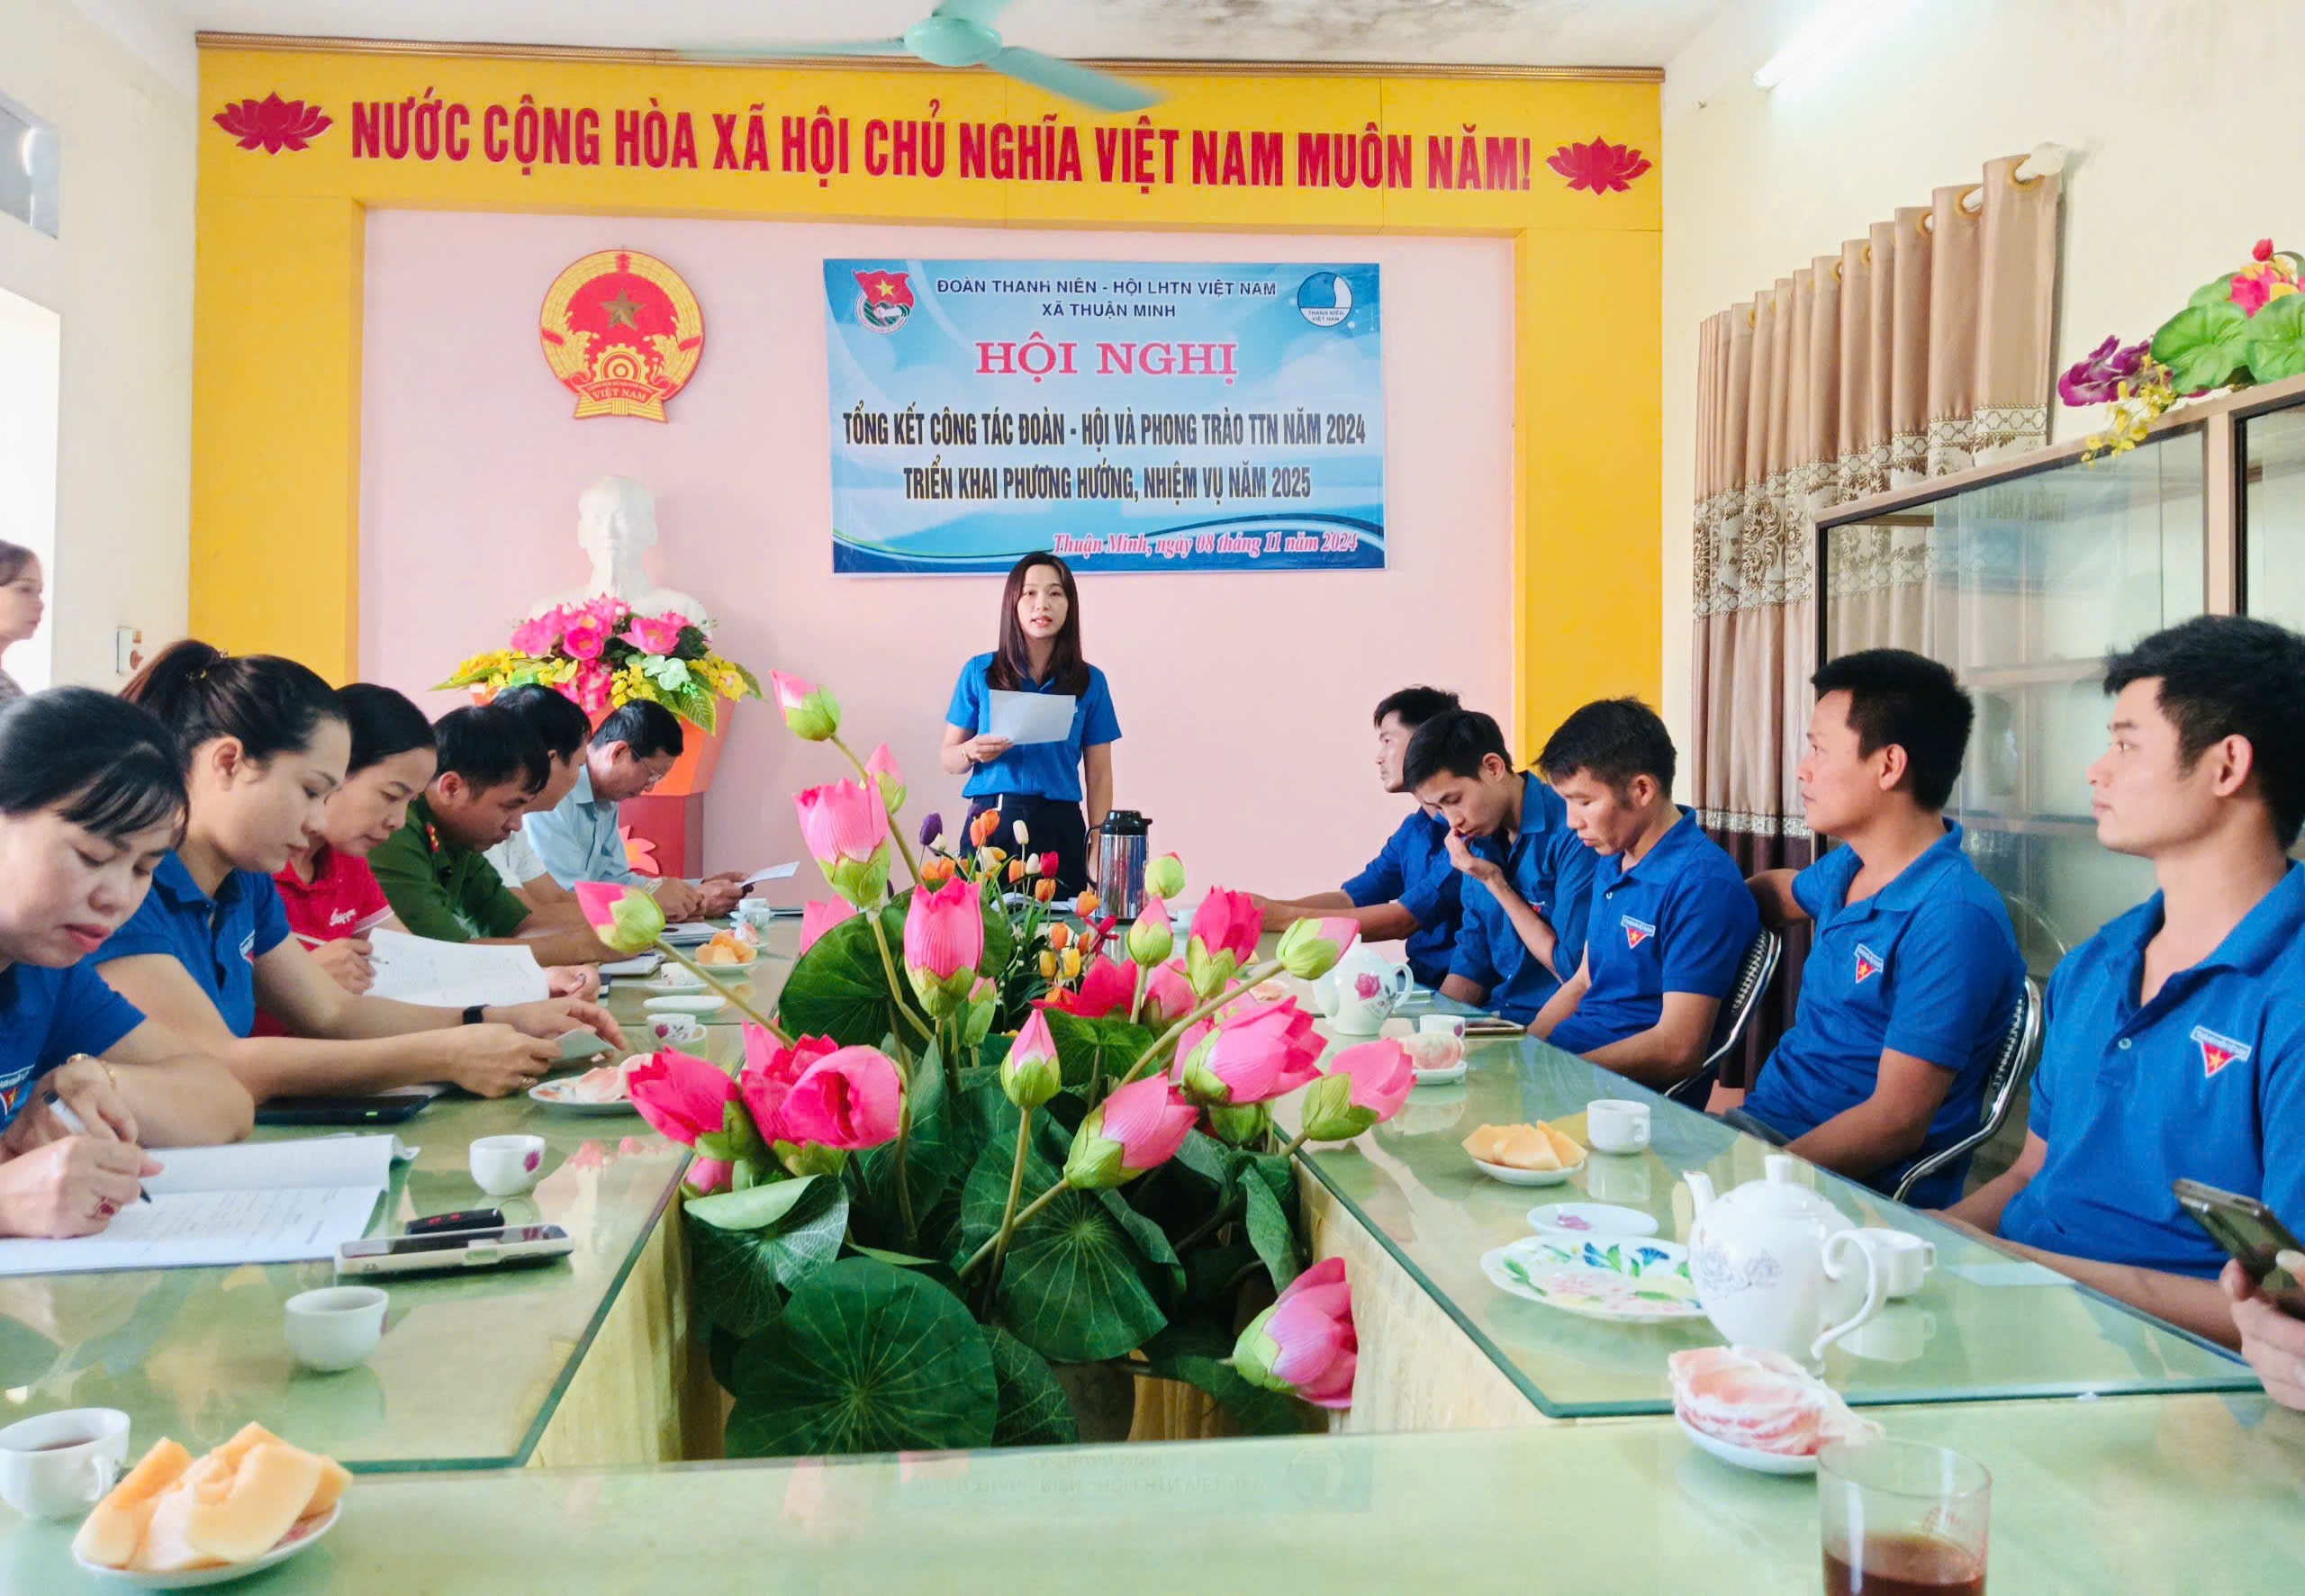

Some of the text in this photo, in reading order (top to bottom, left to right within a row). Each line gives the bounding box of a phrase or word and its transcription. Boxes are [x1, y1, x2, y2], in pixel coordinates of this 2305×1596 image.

[352, 86, 1531, 194] NƯỚC CỘNG HÒA XÃ HỘI CHỦ NGHĨA VIỆT NAM MUÔN NĂM!
[937, 276, 986, 293] ĐOÀN
[992, 280, 1051, 293] THANH
[1057, 277, 1097, 293] NIÊN
[1114, 278, 1142, 296] HỘI
[1148, 282, 1191, 294] LHTN
[1198, 279, 1234, 297] VIỆT
[1240, 283, 1276, 295] NAM
[1043, 301, 1175, 319] XÃ THUẬN MINH
[975, 331, 1237, 385] HỘI NGHỊ
[843, 400, 888, 445] TỔNG
[894, 401, 925, 445] KẾT
[930, 406, 976, 446] CÔNG
[981, 406, 1013, 445] TÁC
[1018, 406, 1064, 445] ĐOÀN
[1081, 407, 1109, 453] HỘI
[1115, 407, 1135, 445] VÀ
[1141, 413, 1197, 445] PHONG
[1202, 406, 1243, 445] TRÀO
[1249, 413, 1278, 445] TTN
[1283, 407, 1321, 445] NĂM
[1326, 413, 1365, 444] 2024
[904, 454, 1311, 505] TRIỂN KHAI PHƯƠNG HƯỚNG, NHIỆM VỤ NĂM 2025
[1054, 531, 1358, 558] Thuận Minh, ngày 08 tháng 11 năm 2024
